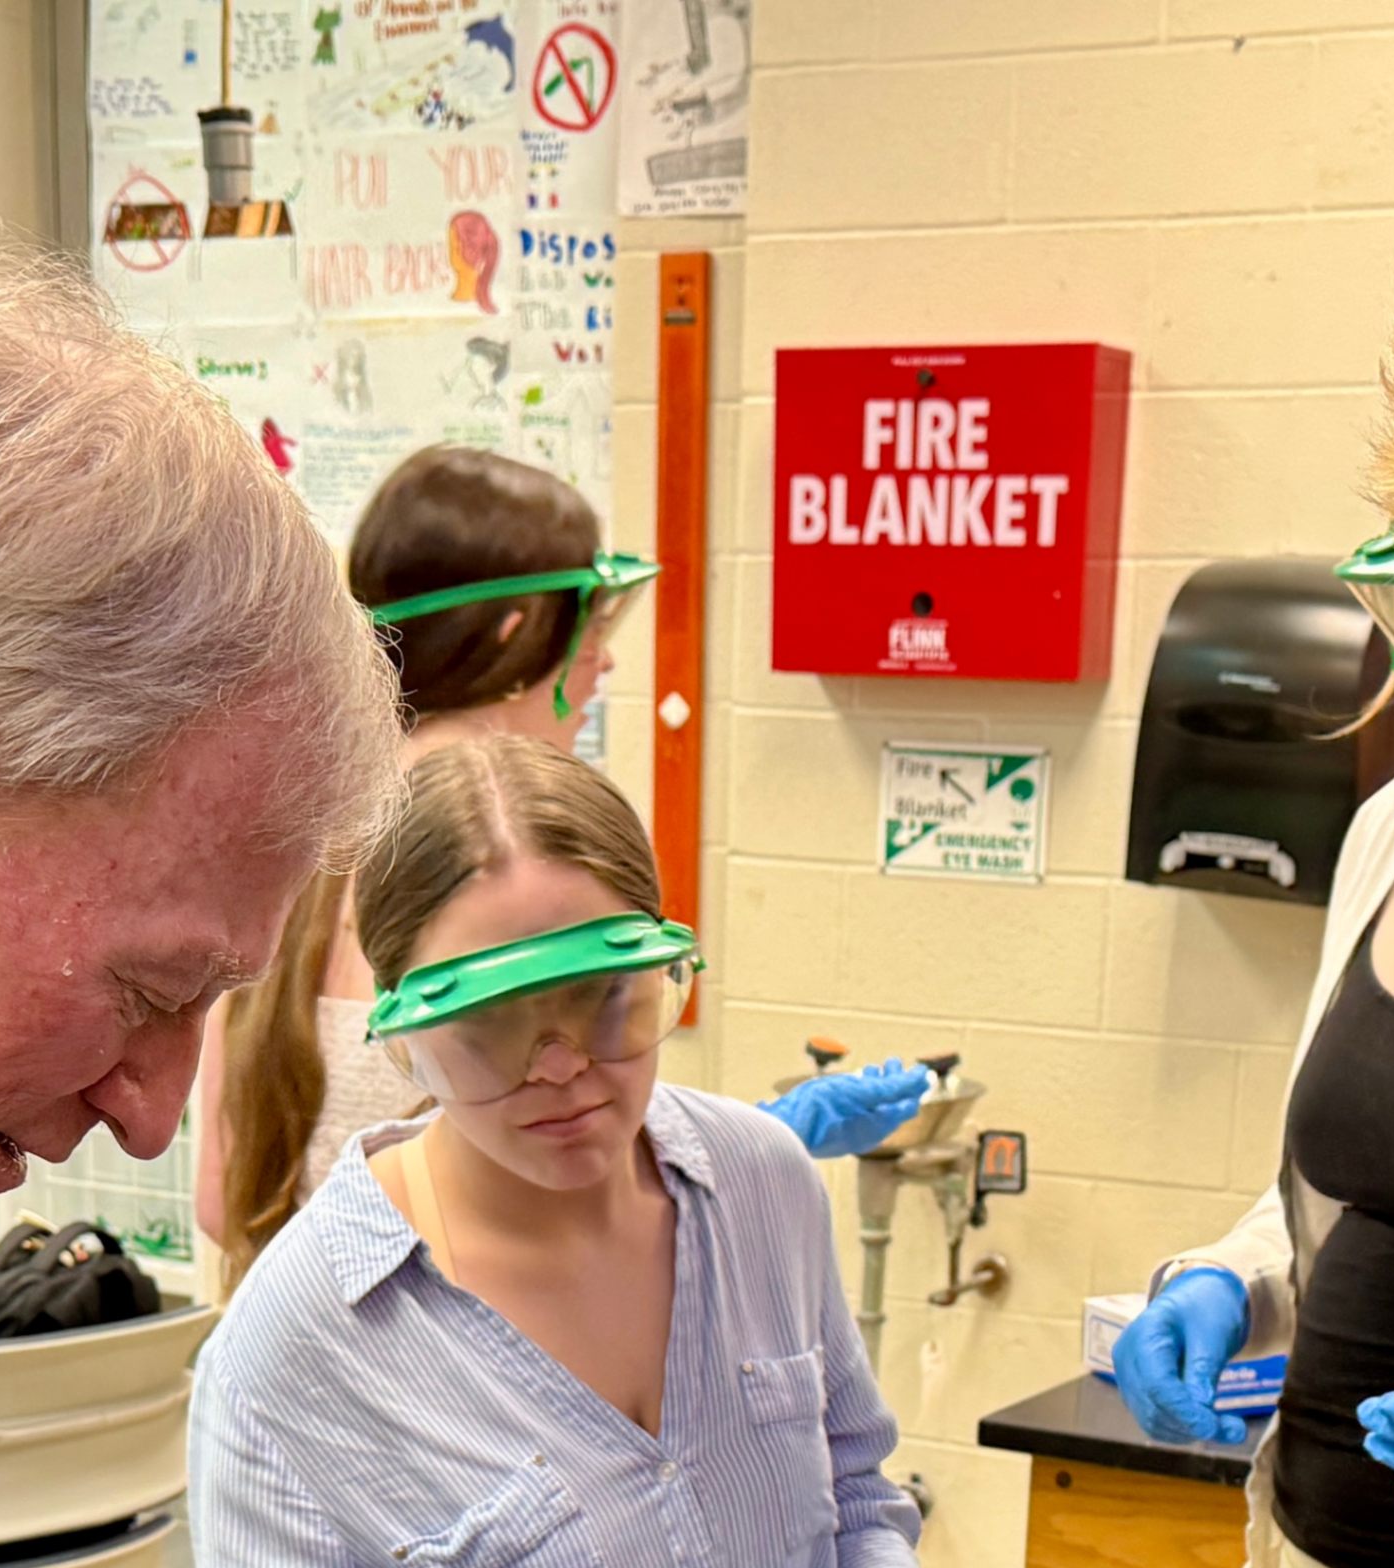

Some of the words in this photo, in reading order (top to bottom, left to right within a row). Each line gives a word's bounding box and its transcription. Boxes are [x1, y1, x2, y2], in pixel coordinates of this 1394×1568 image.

[862, 398, 991, 471] FIRE
[788, 473, 1070, 547] BLANKET
[896, 758, 934, 780] Fire
[895, 797, 967, 819] Blanket
[936, 832, 1033, 852] EMERGENCY
[943, 852, 972, 869] EYE
[977, 853, 1023, 870] WASH
